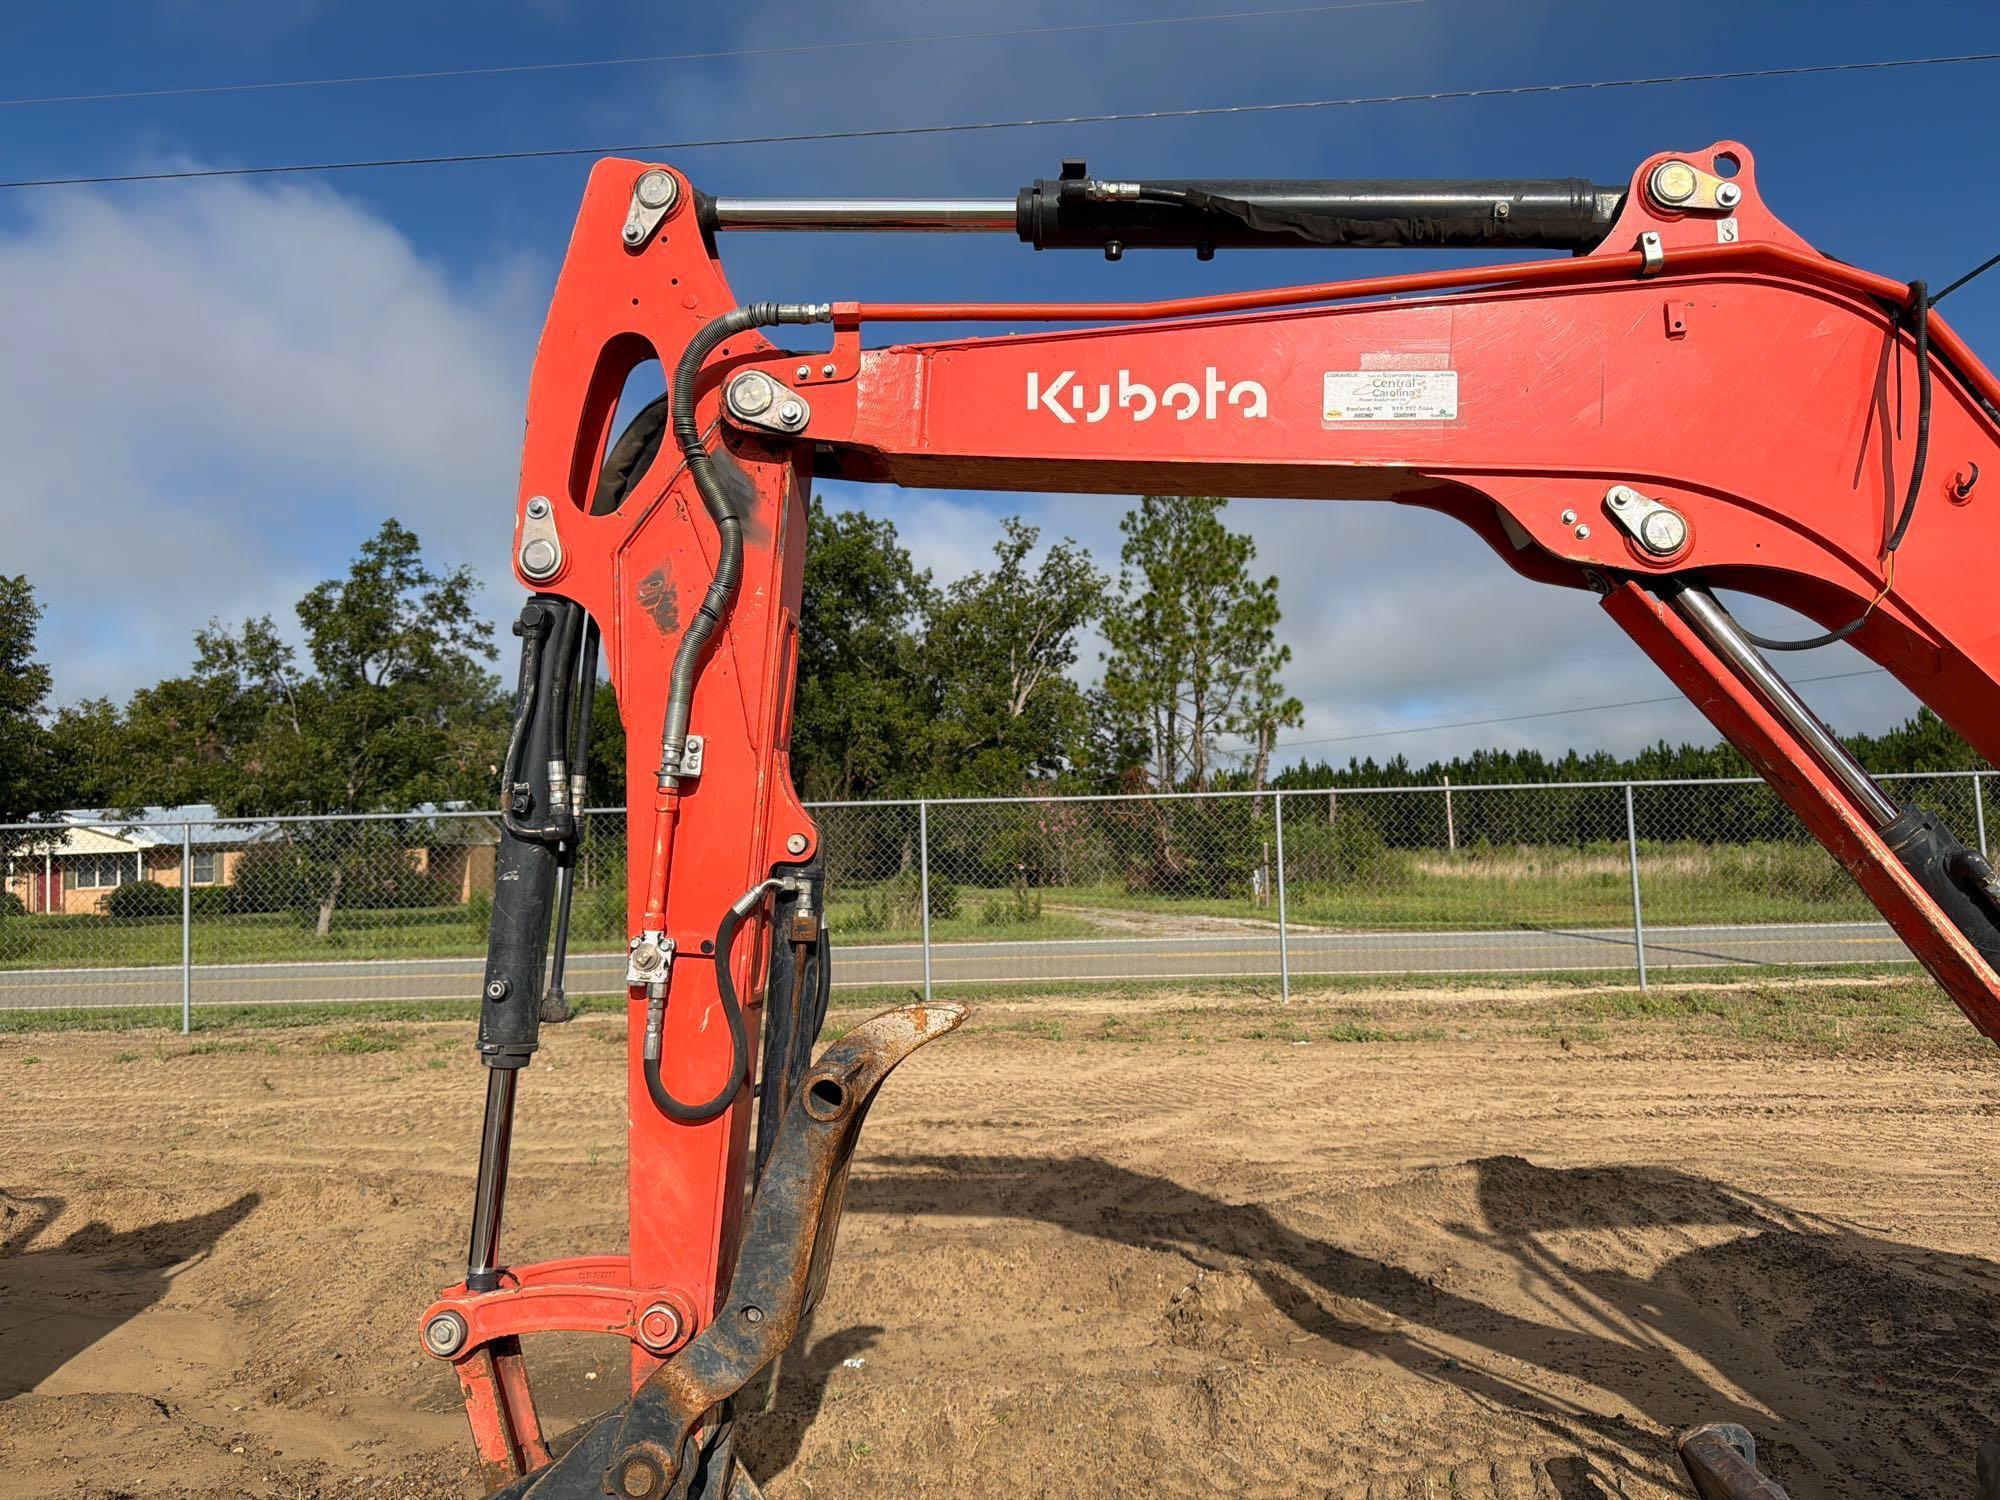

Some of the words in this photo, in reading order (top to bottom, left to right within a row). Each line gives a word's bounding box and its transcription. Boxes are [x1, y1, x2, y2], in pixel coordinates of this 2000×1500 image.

[1372, 378, 1416, 388] Central
[1026, 366, 1268, 424] Kubota
[1372, 388, 1415, 397] Carolina
